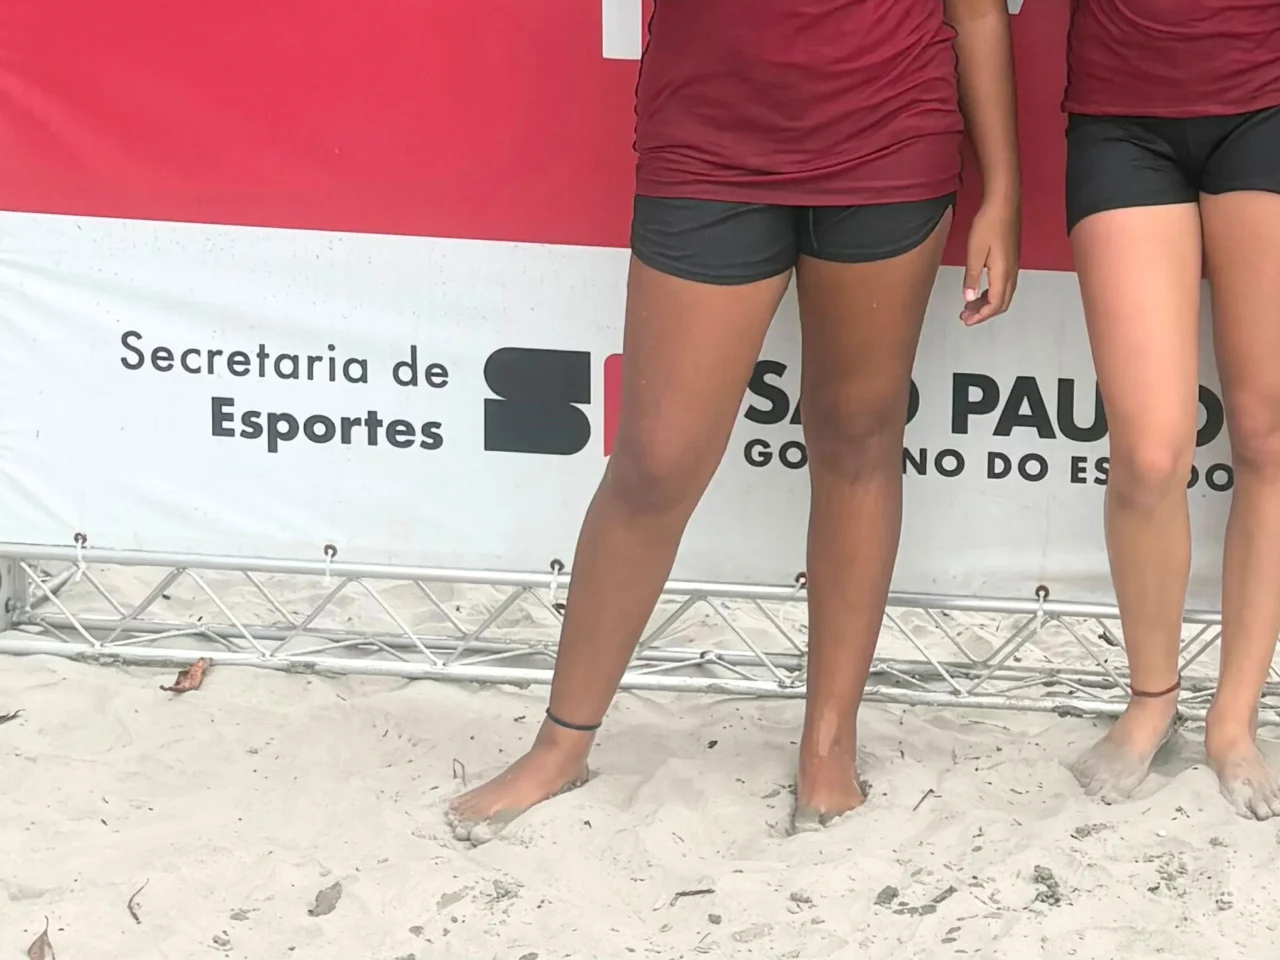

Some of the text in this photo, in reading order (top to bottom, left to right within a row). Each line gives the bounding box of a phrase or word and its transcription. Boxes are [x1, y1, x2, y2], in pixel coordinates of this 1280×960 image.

[120, 330, 450, 389] Secretaria de
[210, 396, 444, 453] Esportes
[743, 438, 1234, 492] GONO DO ESO
